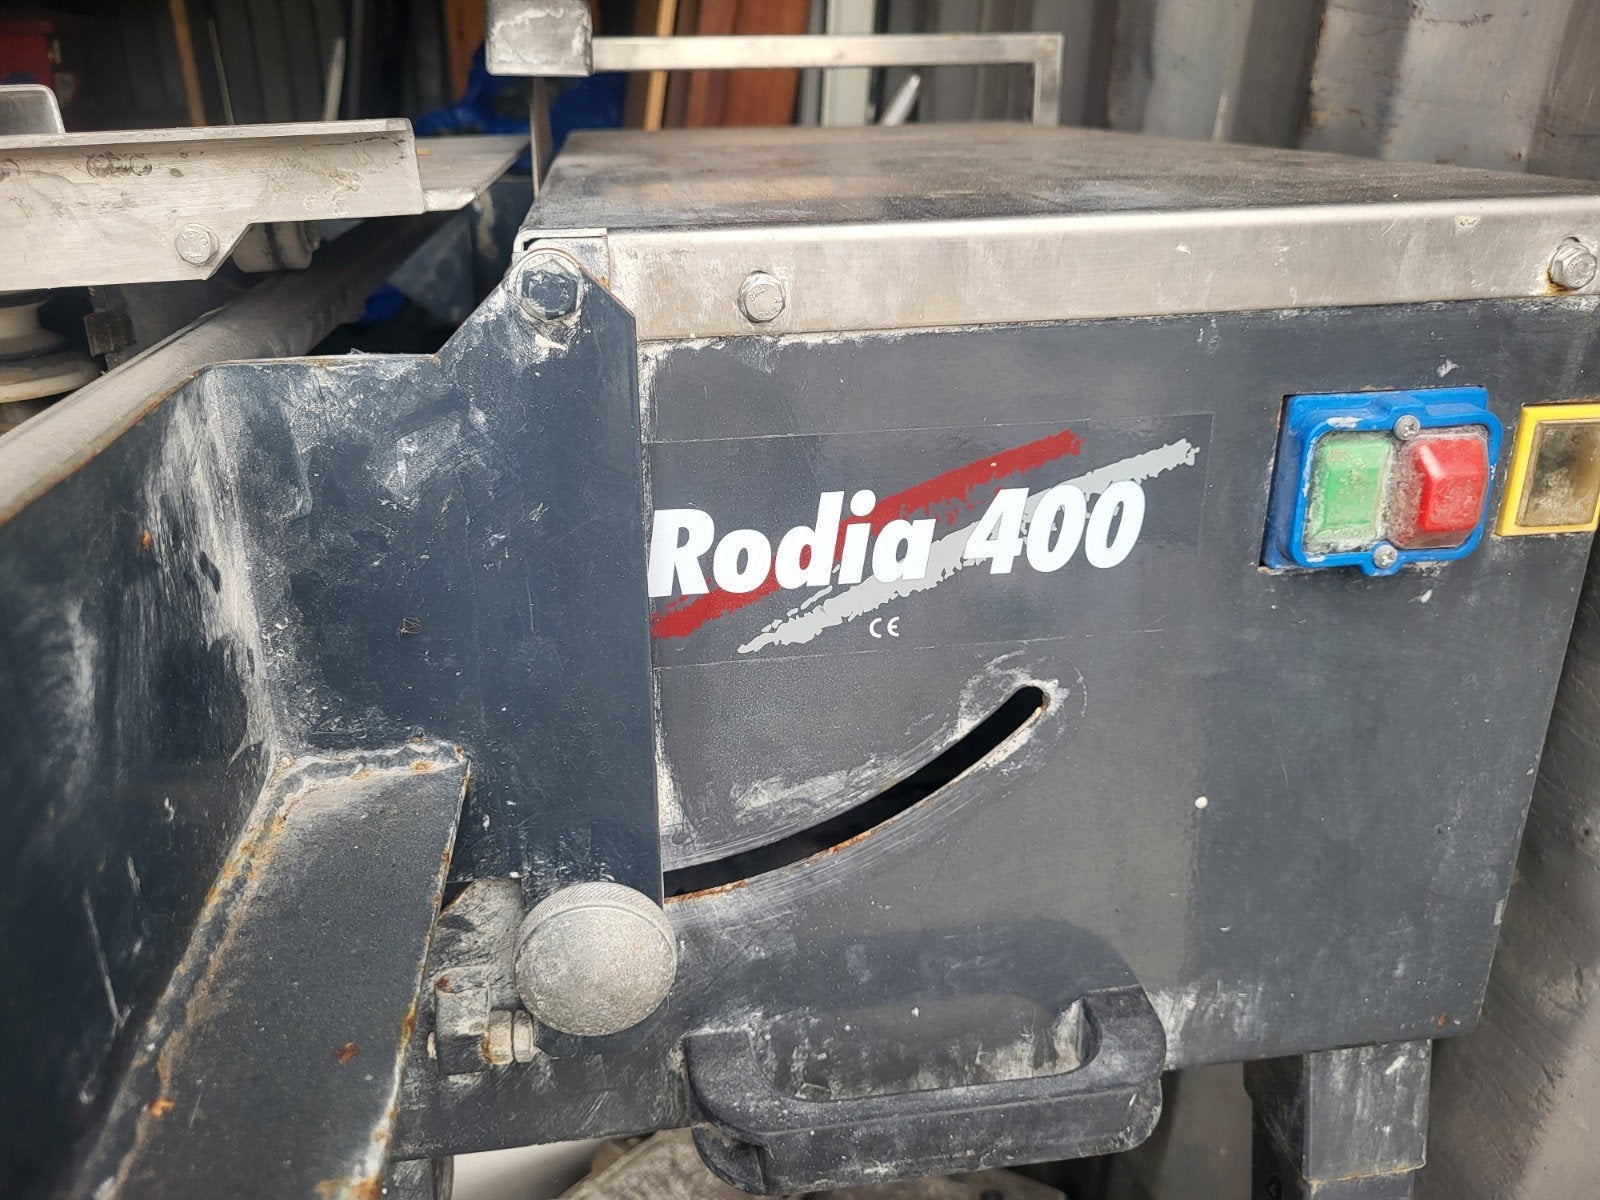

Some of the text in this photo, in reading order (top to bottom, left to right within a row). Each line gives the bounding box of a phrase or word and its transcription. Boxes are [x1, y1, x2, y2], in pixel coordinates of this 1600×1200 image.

[648, 480, 1146, 598] Rodia 400
[868, 616, 900, 639] CE
